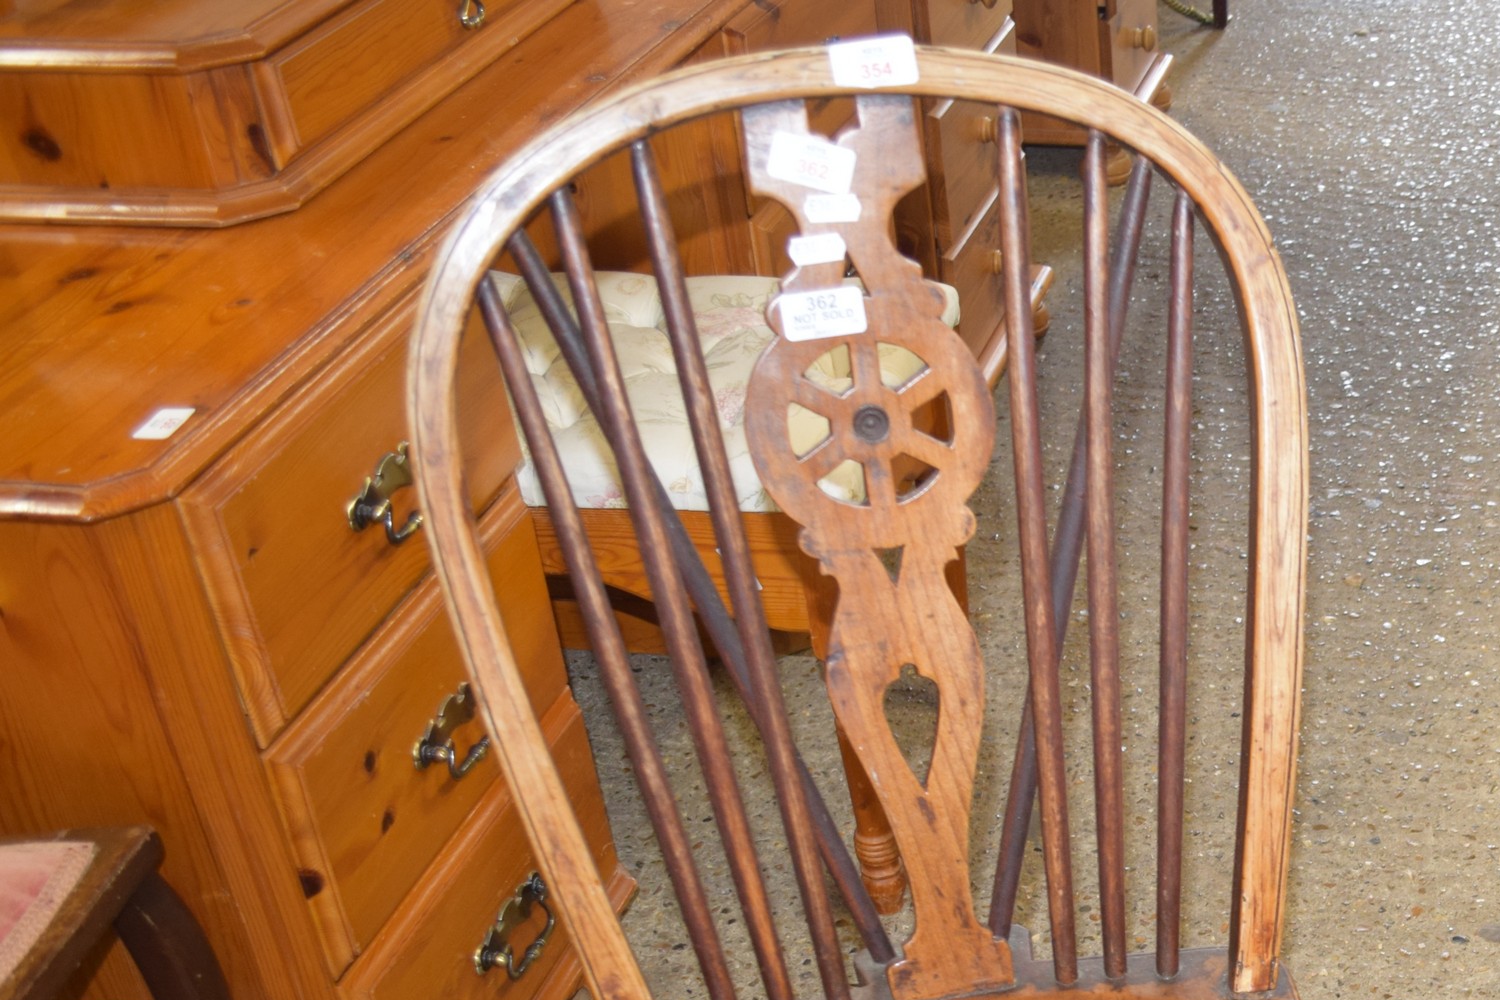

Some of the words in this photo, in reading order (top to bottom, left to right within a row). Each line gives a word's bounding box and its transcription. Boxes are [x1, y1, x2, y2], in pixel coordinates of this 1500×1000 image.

[860, 61, 893, 79] 354
[798, 159, 829, 180] 362
[805, 293, 837, 311] 362
[793, 312, 816, 324] NOT
[821, 308, 854, 321] SOLD
